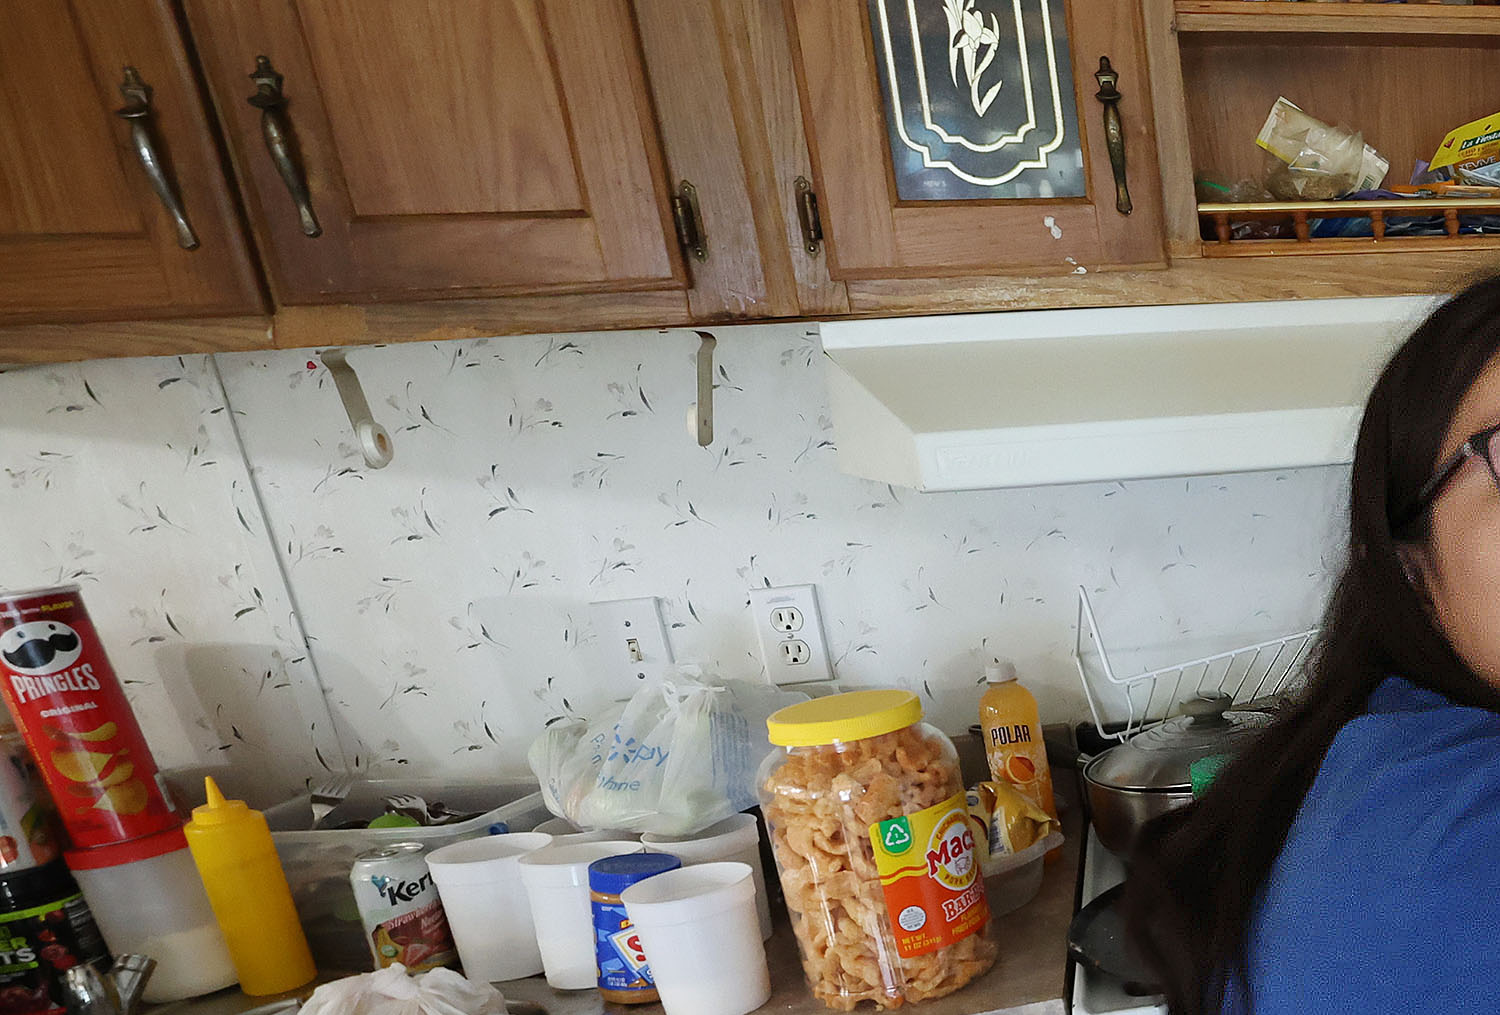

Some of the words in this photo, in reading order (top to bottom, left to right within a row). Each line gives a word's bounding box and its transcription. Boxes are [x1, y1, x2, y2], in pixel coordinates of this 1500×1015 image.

[10, 663, 101, 704] PRINGLES
[40, 701, 98, 718] ORIGINAL
[990, 724, 1032, 747] POLAR
